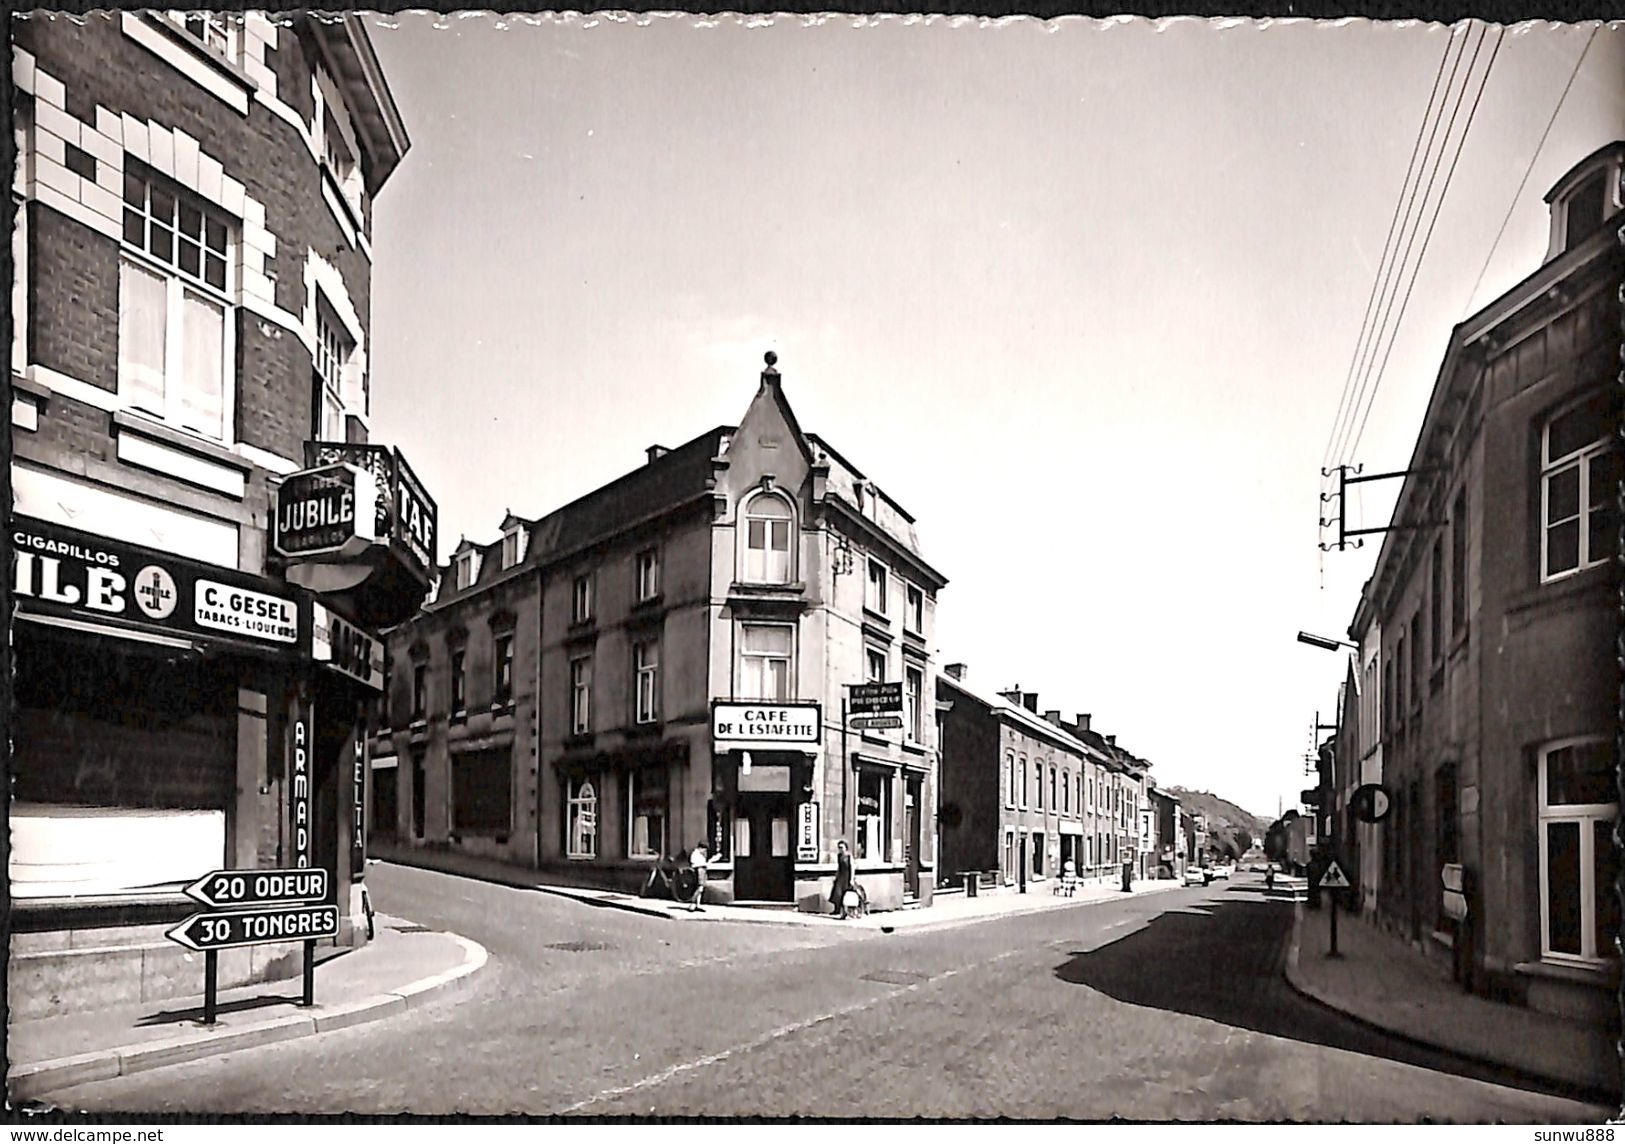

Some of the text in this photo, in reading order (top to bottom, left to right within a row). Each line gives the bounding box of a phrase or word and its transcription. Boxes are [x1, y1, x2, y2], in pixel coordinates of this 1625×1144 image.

[280, 488, 353, 533] JUBILÉ
[13, 532, 120, 566] CIGARILLOS
[205, 588, 291, 623] C. GESEL
[718, 723, 733, 734] DE
[214, 875, 323, 899] 20 ODEUR
[200, 911, 335, 942] 30 TONGRES
